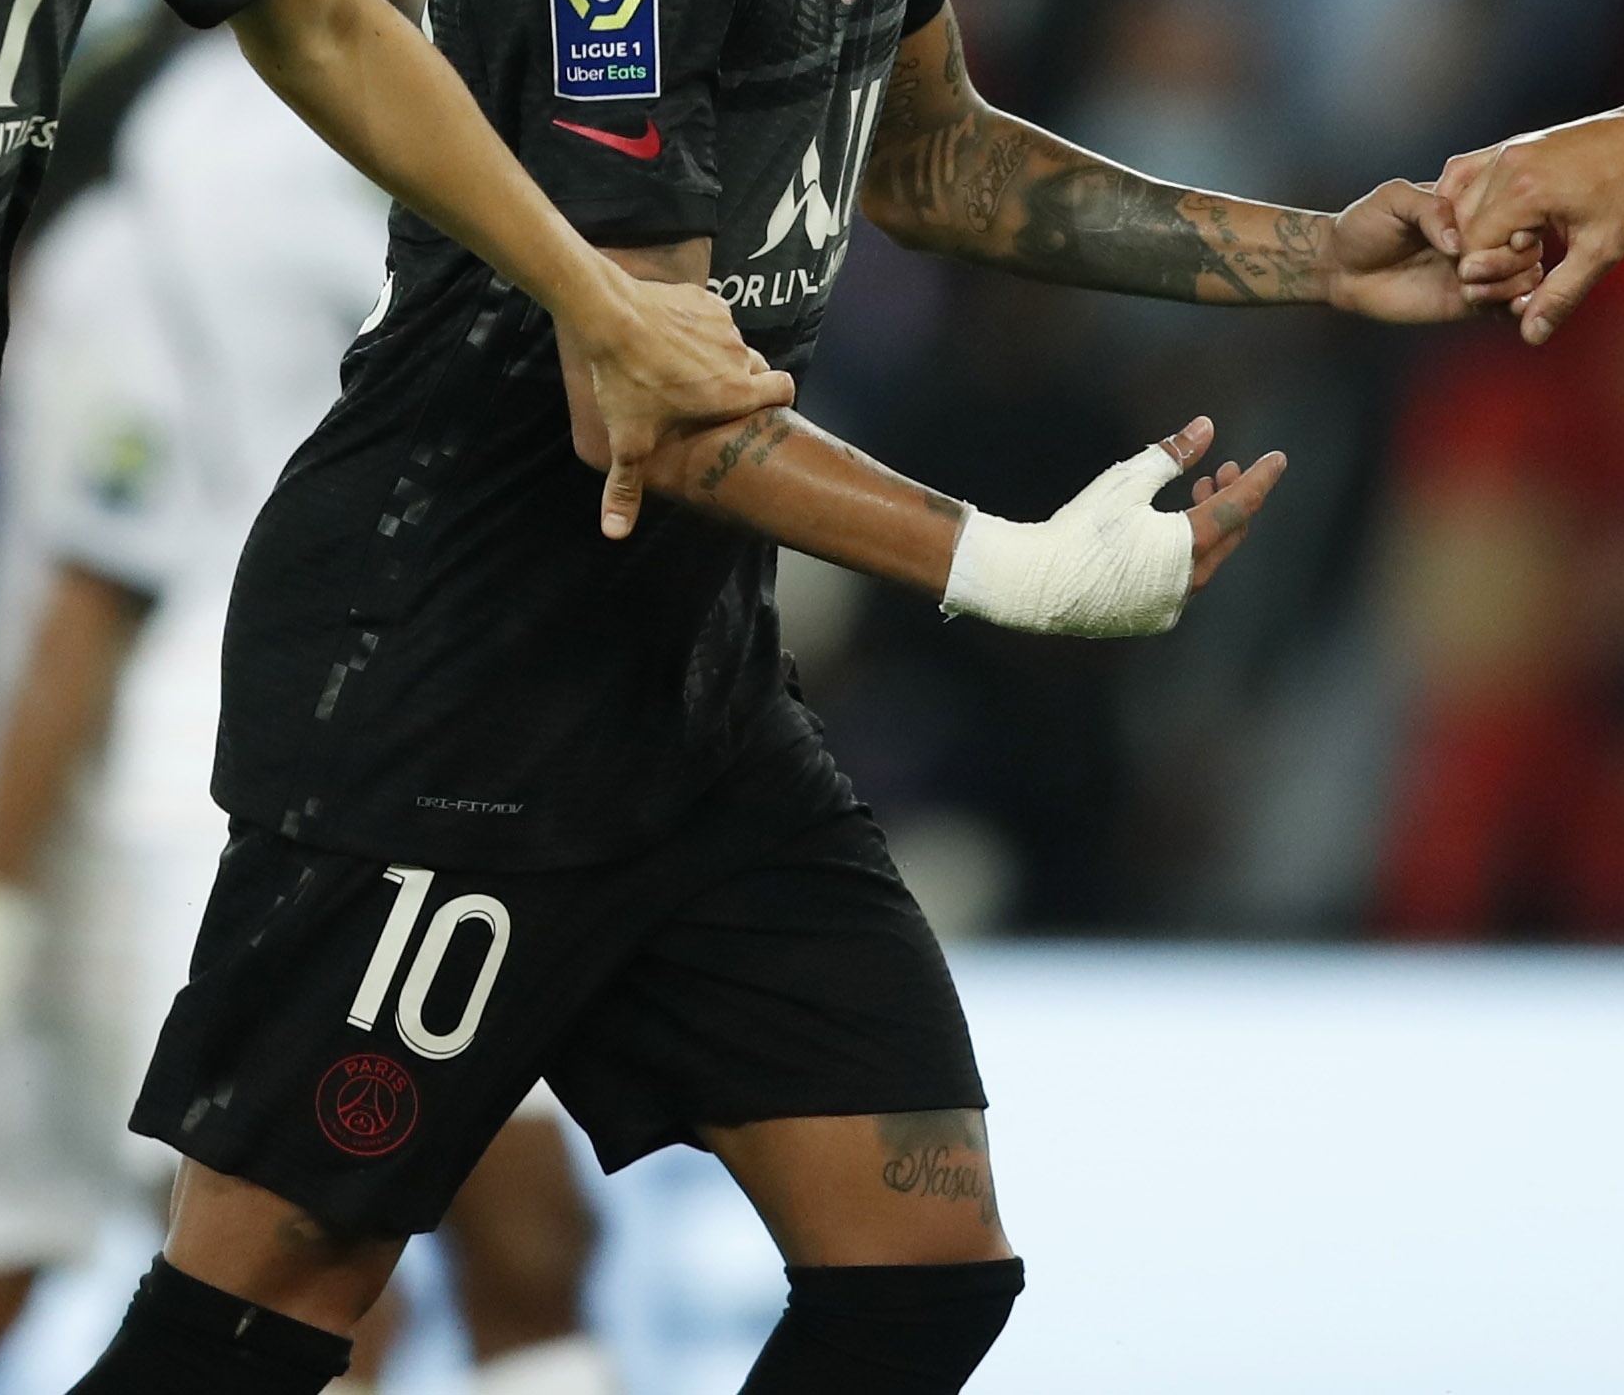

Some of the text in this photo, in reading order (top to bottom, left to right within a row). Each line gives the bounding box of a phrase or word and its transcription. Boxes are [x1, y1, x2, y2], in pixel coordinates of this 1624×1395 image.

[571, 41, 641, 59] LIGUE 1
[566, 64, 647, 82] Uber Eats
[346, 866, 511, 1060] 10
[344, 1058, 408, 1093] PARIS
